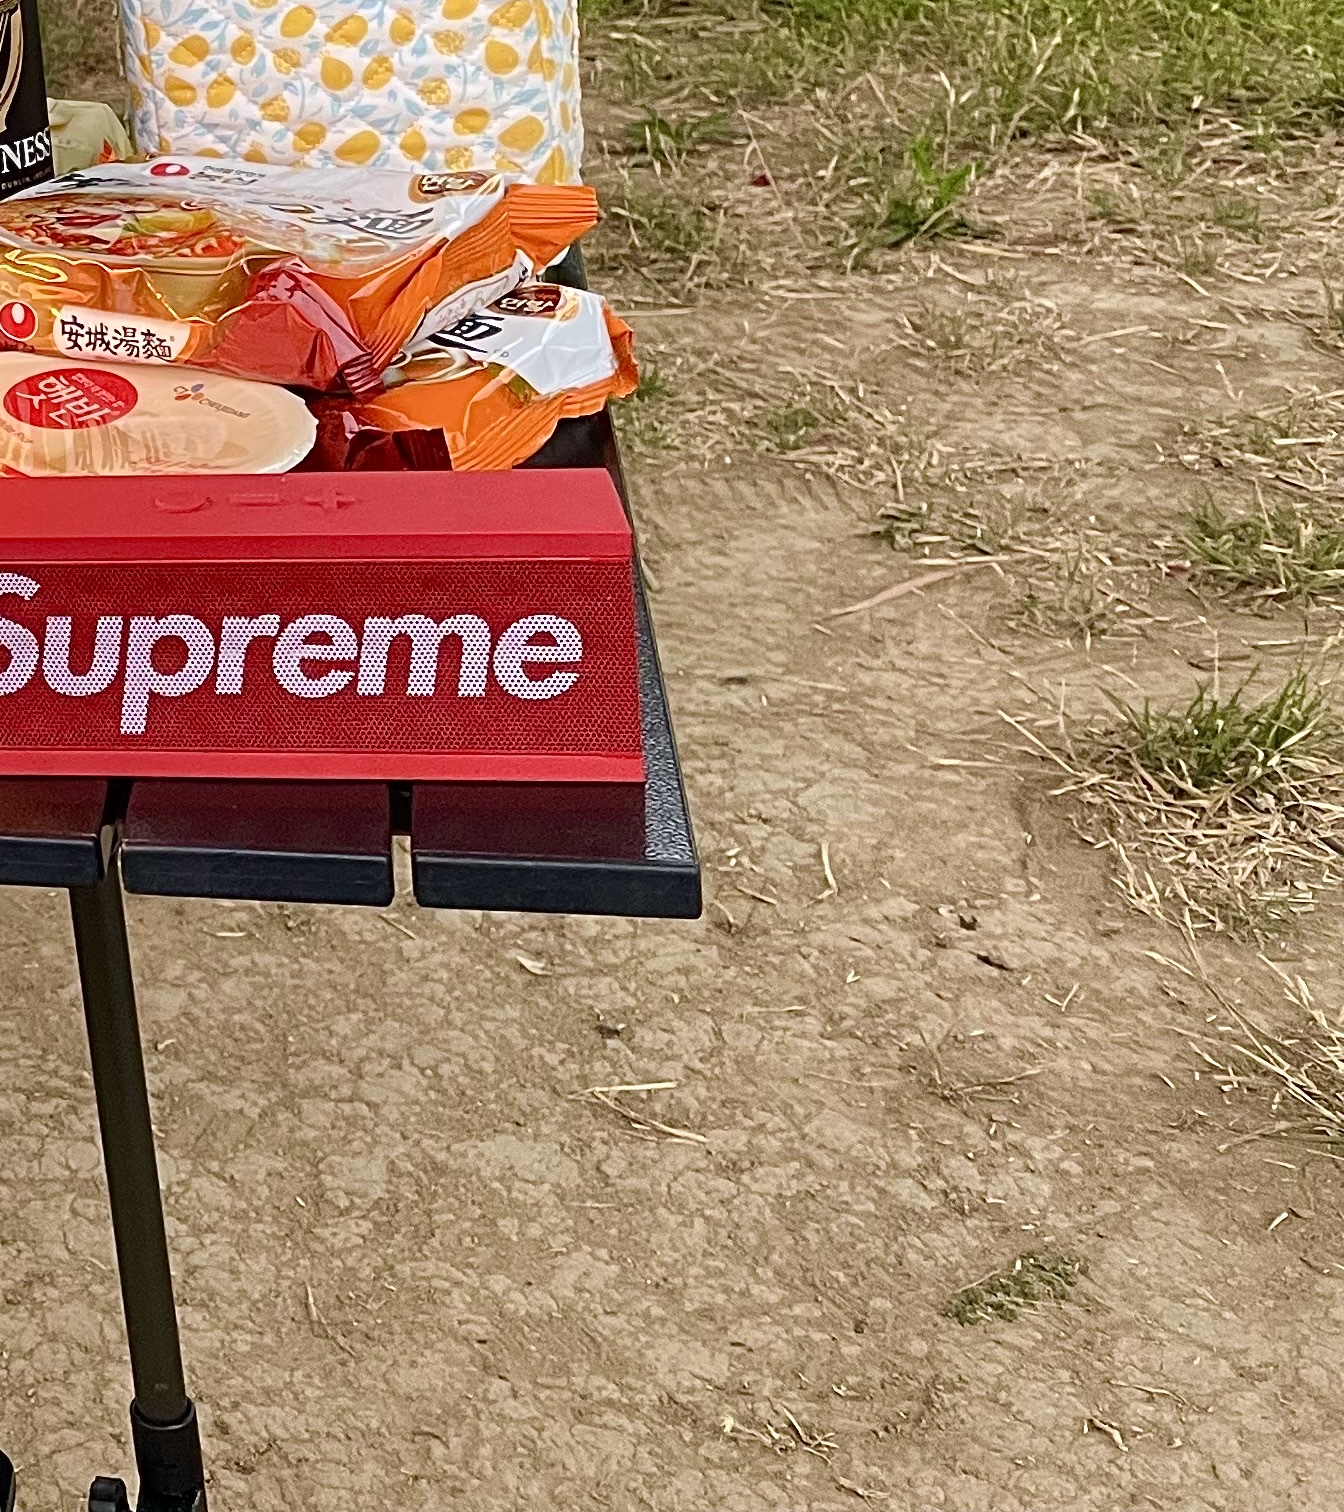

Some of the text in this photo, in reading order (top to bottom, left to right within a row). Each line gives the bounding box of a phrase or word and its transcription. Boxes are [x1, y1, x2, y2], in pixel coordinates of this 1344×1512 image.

[60, 314, 174, 363] 安城湯麵
[15, 374, 112, 427] 햇반
